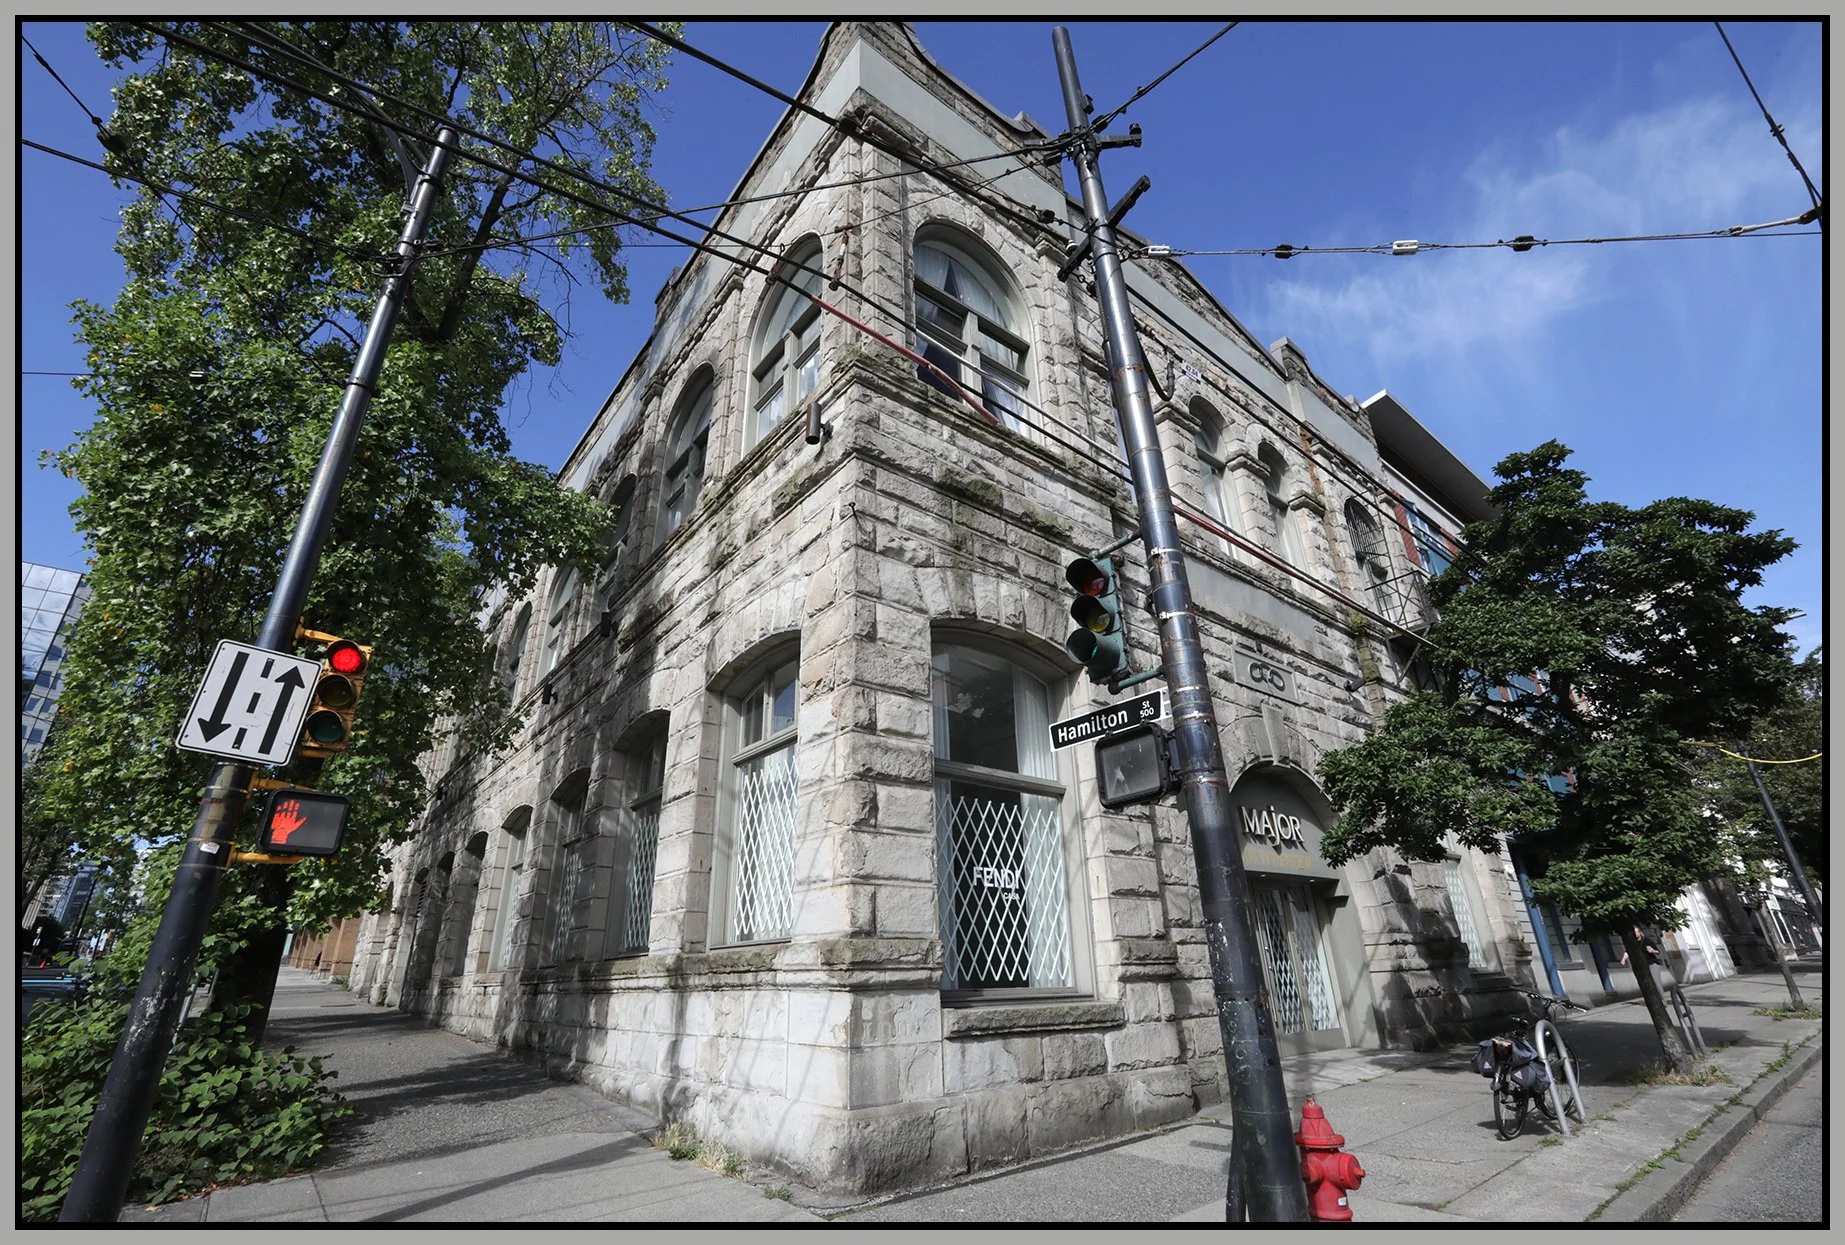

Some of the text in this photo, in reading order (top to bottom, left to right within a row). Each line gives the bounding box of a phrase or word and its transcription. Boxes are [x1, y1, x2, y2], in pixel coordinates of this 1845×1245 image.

[1142, 700, 1150, 709] St
[1140, 707, 1154, 718] 500
[1058, 710, 1128, 743] Hamilton
[973, 866, 1020, 889] FENDI
[1003, 892, 1020, 900] CASA
